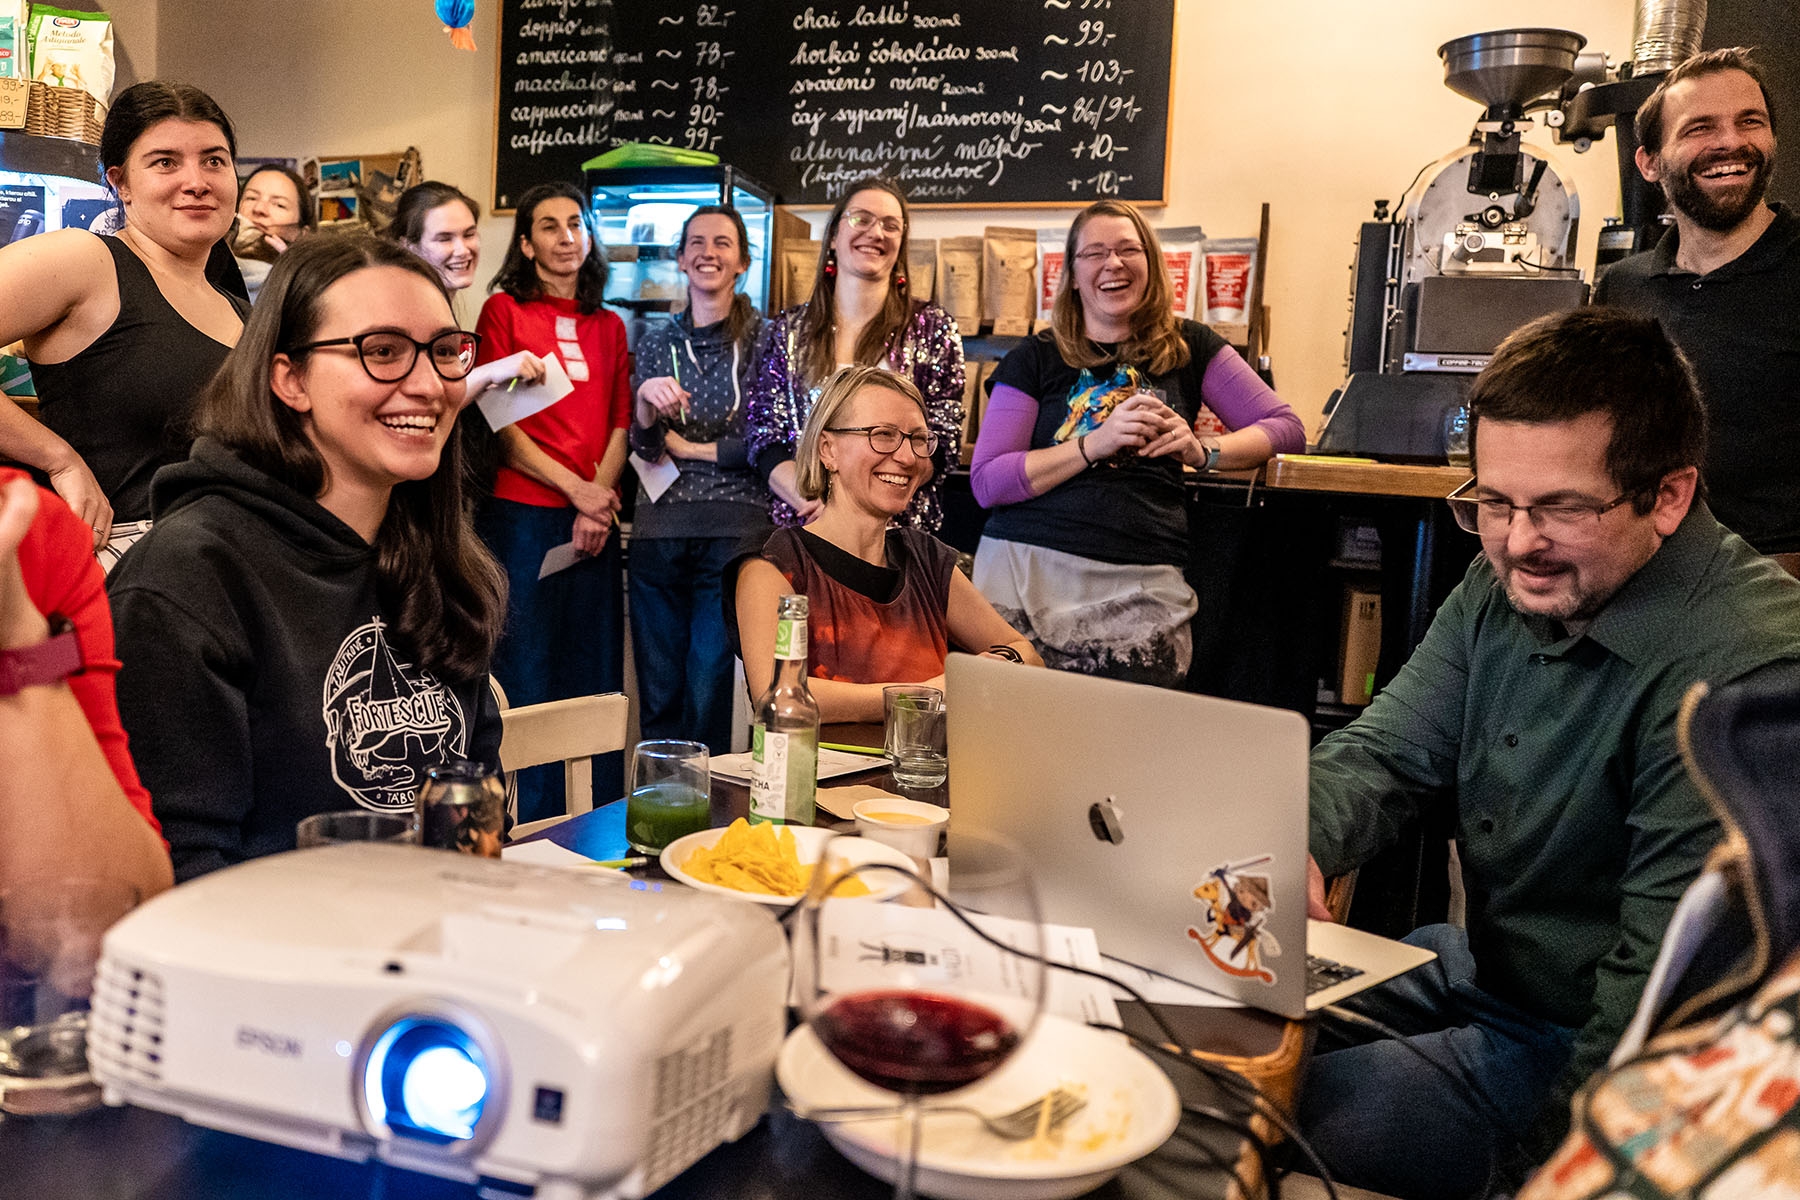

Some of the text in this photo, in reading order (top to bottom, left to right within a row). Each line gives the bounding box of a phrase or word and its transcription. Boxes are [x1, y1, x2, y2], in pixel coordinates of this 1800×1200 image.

[518, 18, 583, 42] doppio
[793, 6, 842, 31] chai
[516, 43, 613, 66] americano
[790, 39, 861, 65] horká
[868, 35, 971, 64] čokoláda
[1073, 19, 1117, 48] 99,-
[513, 70, 612, 93] macchiato
[889, 66, 946, 92] víno
[1076, 58, 1135, 86] 103,-
[510, 100, 614, 129] cappuccino
[688, 103, 725, 127] 90,-
[791, 99, 828, 138] čaj
[684, 126, 723, 151] 99,-
[790, 134, 945, 163] alternativní
[348, 693, 449, 733] FORTESCUE
[386, 790, 416, 805] TÁBO
